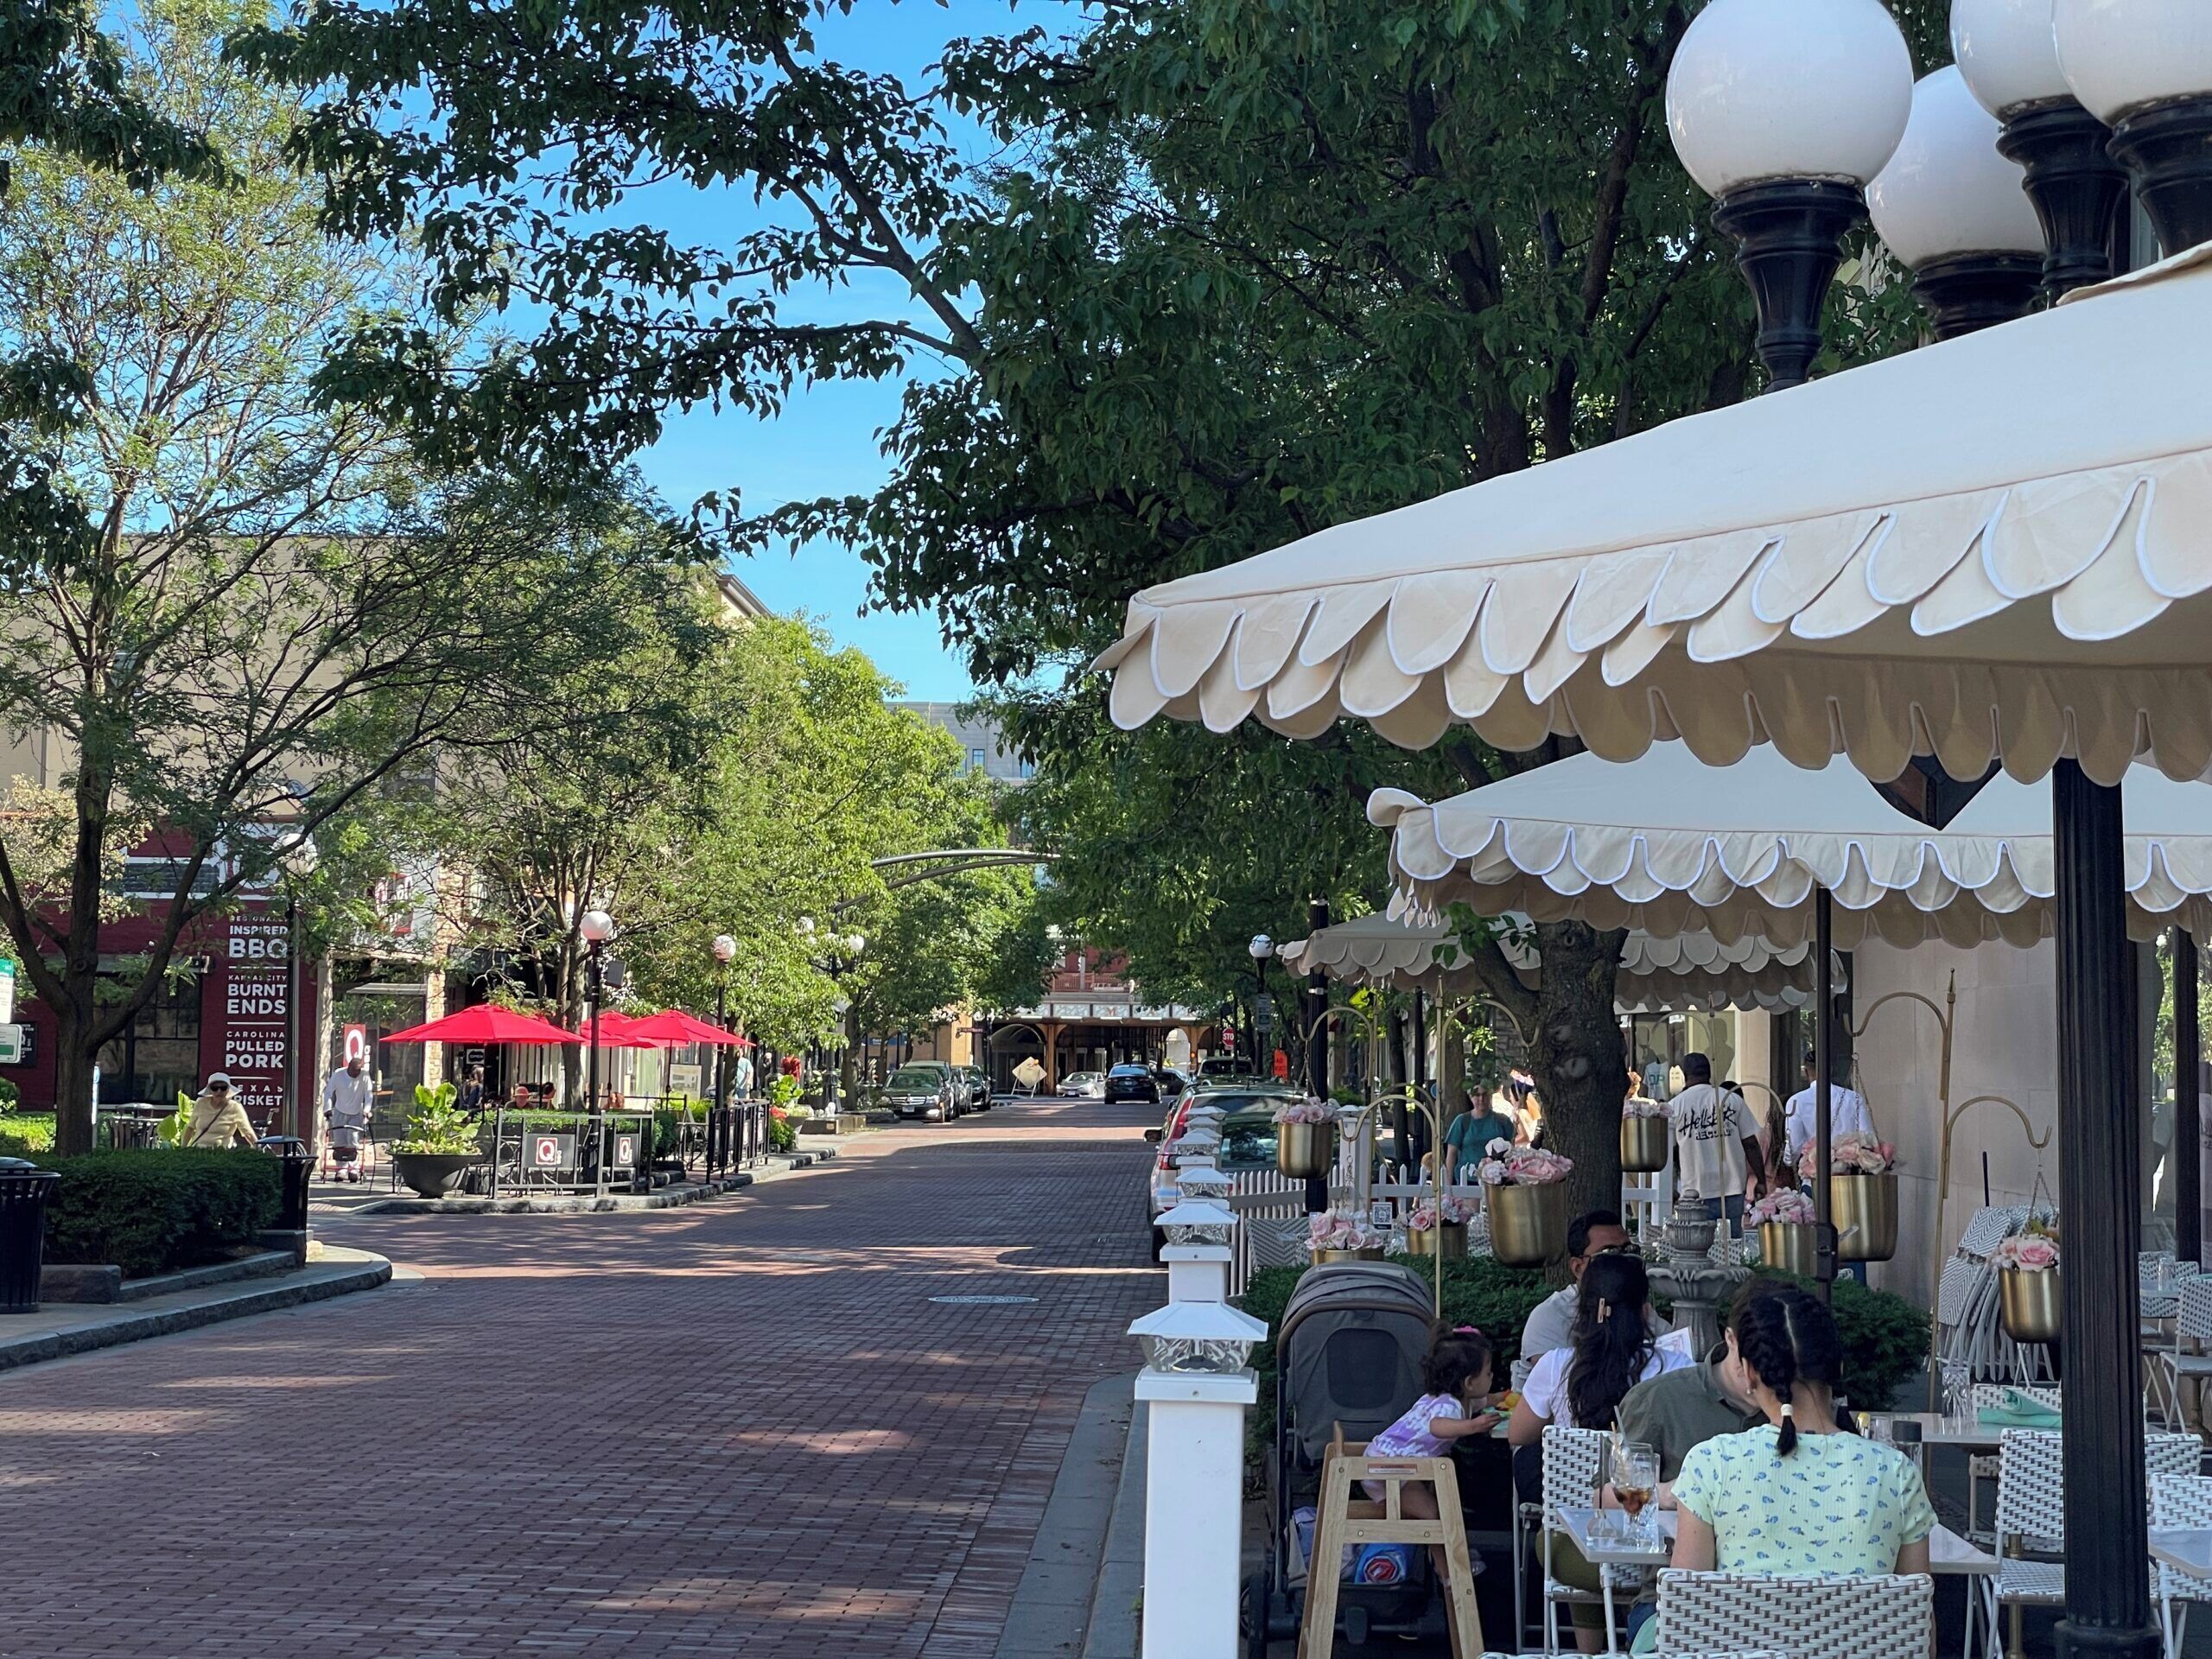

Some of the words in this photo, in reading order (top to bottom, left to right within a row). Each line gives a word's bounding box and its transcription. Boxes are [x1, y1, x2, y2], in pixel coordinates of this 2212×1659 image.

[230, 925, 288, 935] INSPIRED
[229, 938, 288, 959] BBQ
[228, 984, 287, 996] BURNT
[227, 999, 286, 1014] ENDS
[226, 1040, 285, 1052] PULLED
[226, 1054, 283, 1068] PORK
[233, 1095, 283, 1106] RISKET
